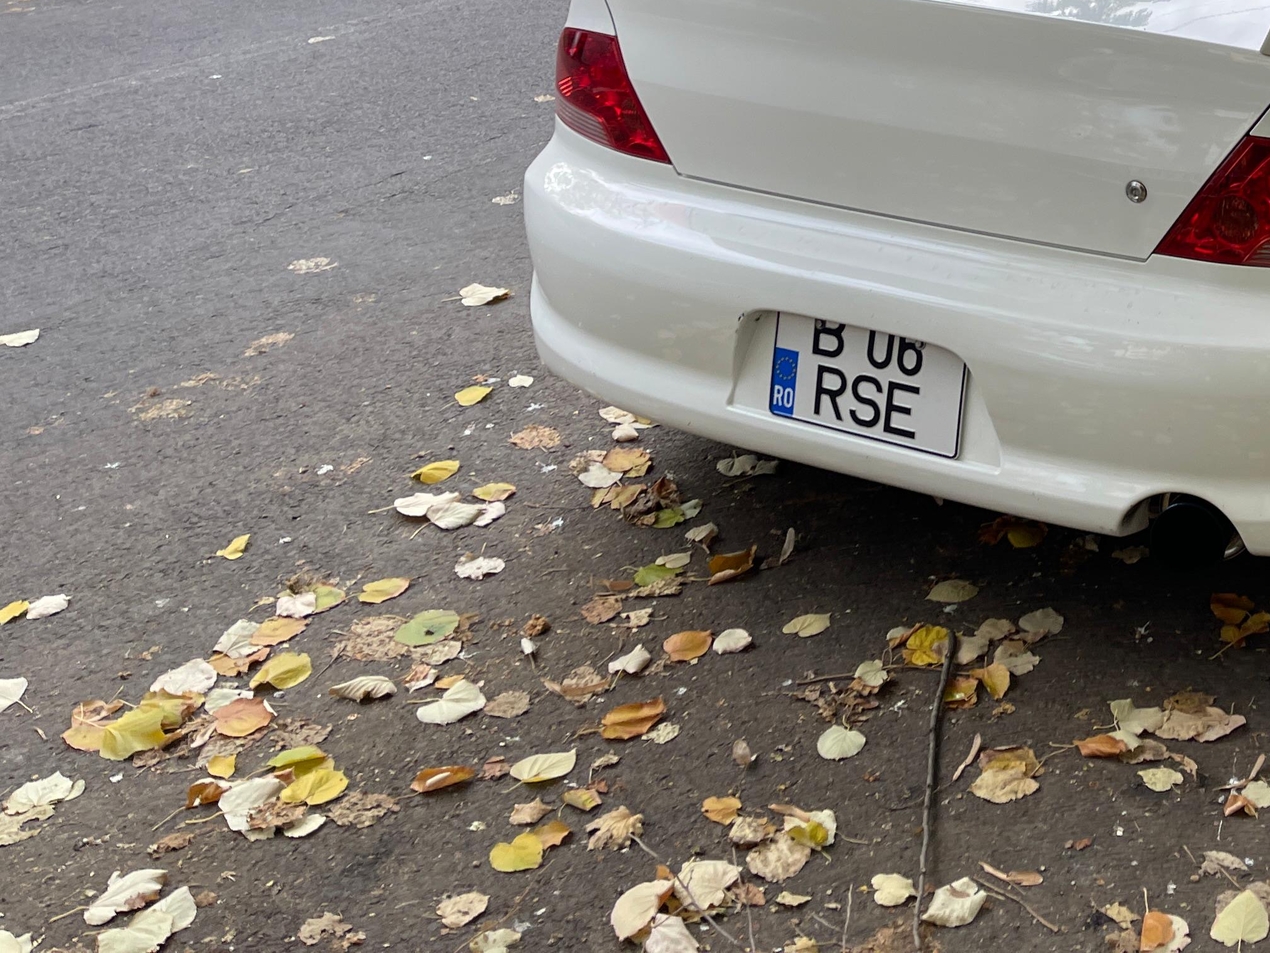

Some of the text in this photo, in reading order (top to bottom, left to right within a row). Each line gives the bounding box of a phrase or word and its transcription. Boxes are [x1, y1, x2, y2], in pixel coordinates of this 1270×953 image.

[812, 318, 847, 358] B
[772, 385, 794, 409] RO
[813, 363, 921, 439] RSE
